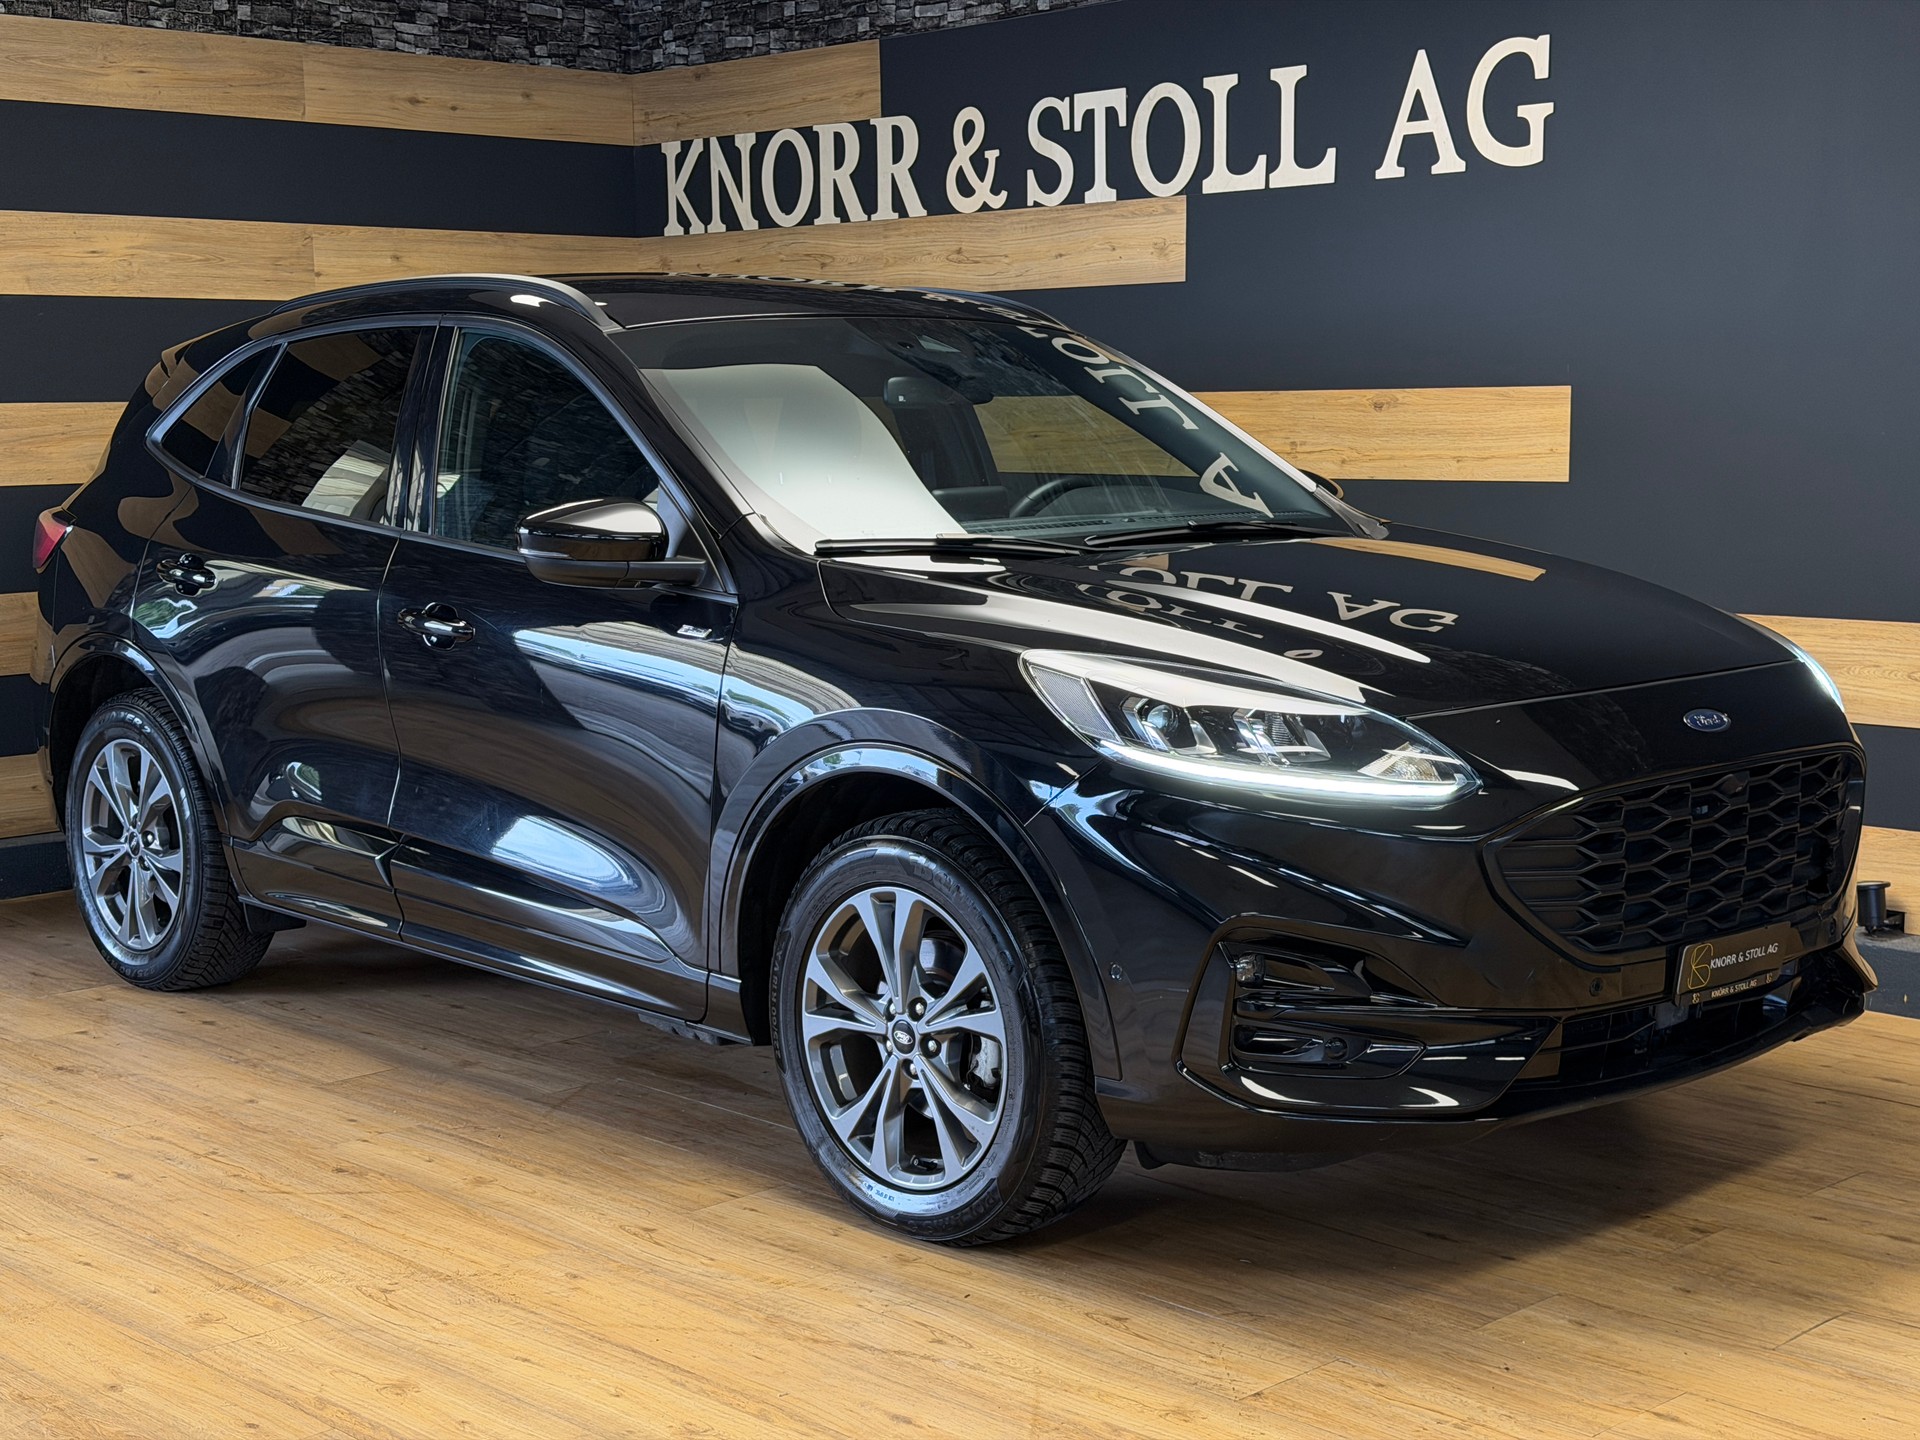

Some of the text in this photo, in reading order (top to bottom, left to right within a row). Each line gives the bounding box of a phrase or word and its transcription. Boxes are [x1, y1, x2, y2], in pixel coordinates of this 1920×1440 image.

[661, 33, 1556, 236] KNORR & STOLL AG
[1710, 943, 1779, 969] KNORR & STOLL AG
